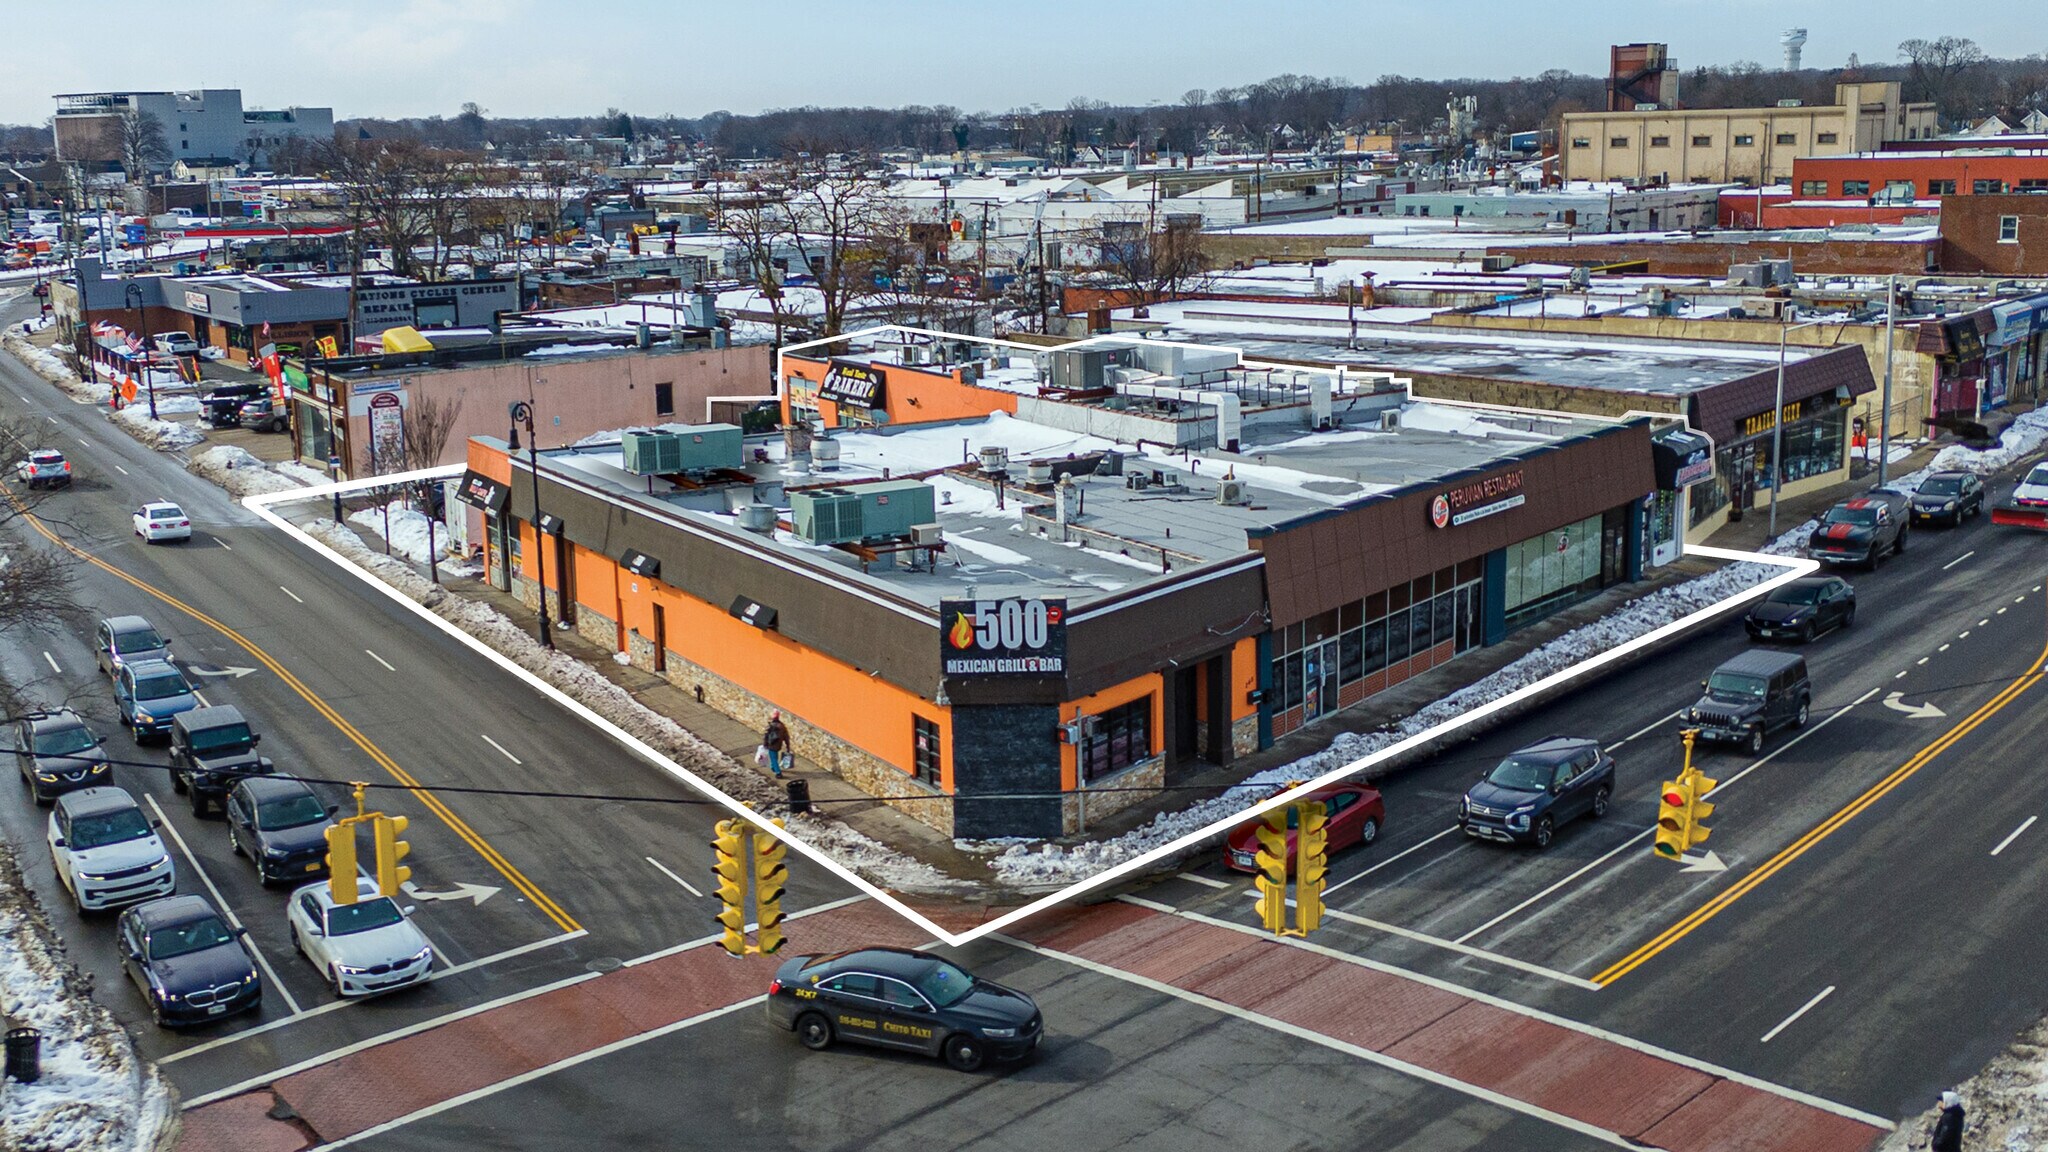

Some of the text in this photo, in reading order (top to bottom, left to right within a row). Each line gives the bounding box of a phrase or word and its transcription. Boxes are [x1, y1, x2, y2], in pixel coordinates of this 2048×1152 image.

[357, 285, 506, 301] ATIONS CYCLES CENTER
[364, 303, 411, 314] REPAIR
[831, 376, 873, 398] BAKERY
[1745, 409, 1777, 436] TRAILE
[1450, 483, 1484, 509] PERUVIAN
[1484, 470, 1524, 498] RESTAURANT
[947, 658, 1062, 674] MEXICAN GRILL & BAR
